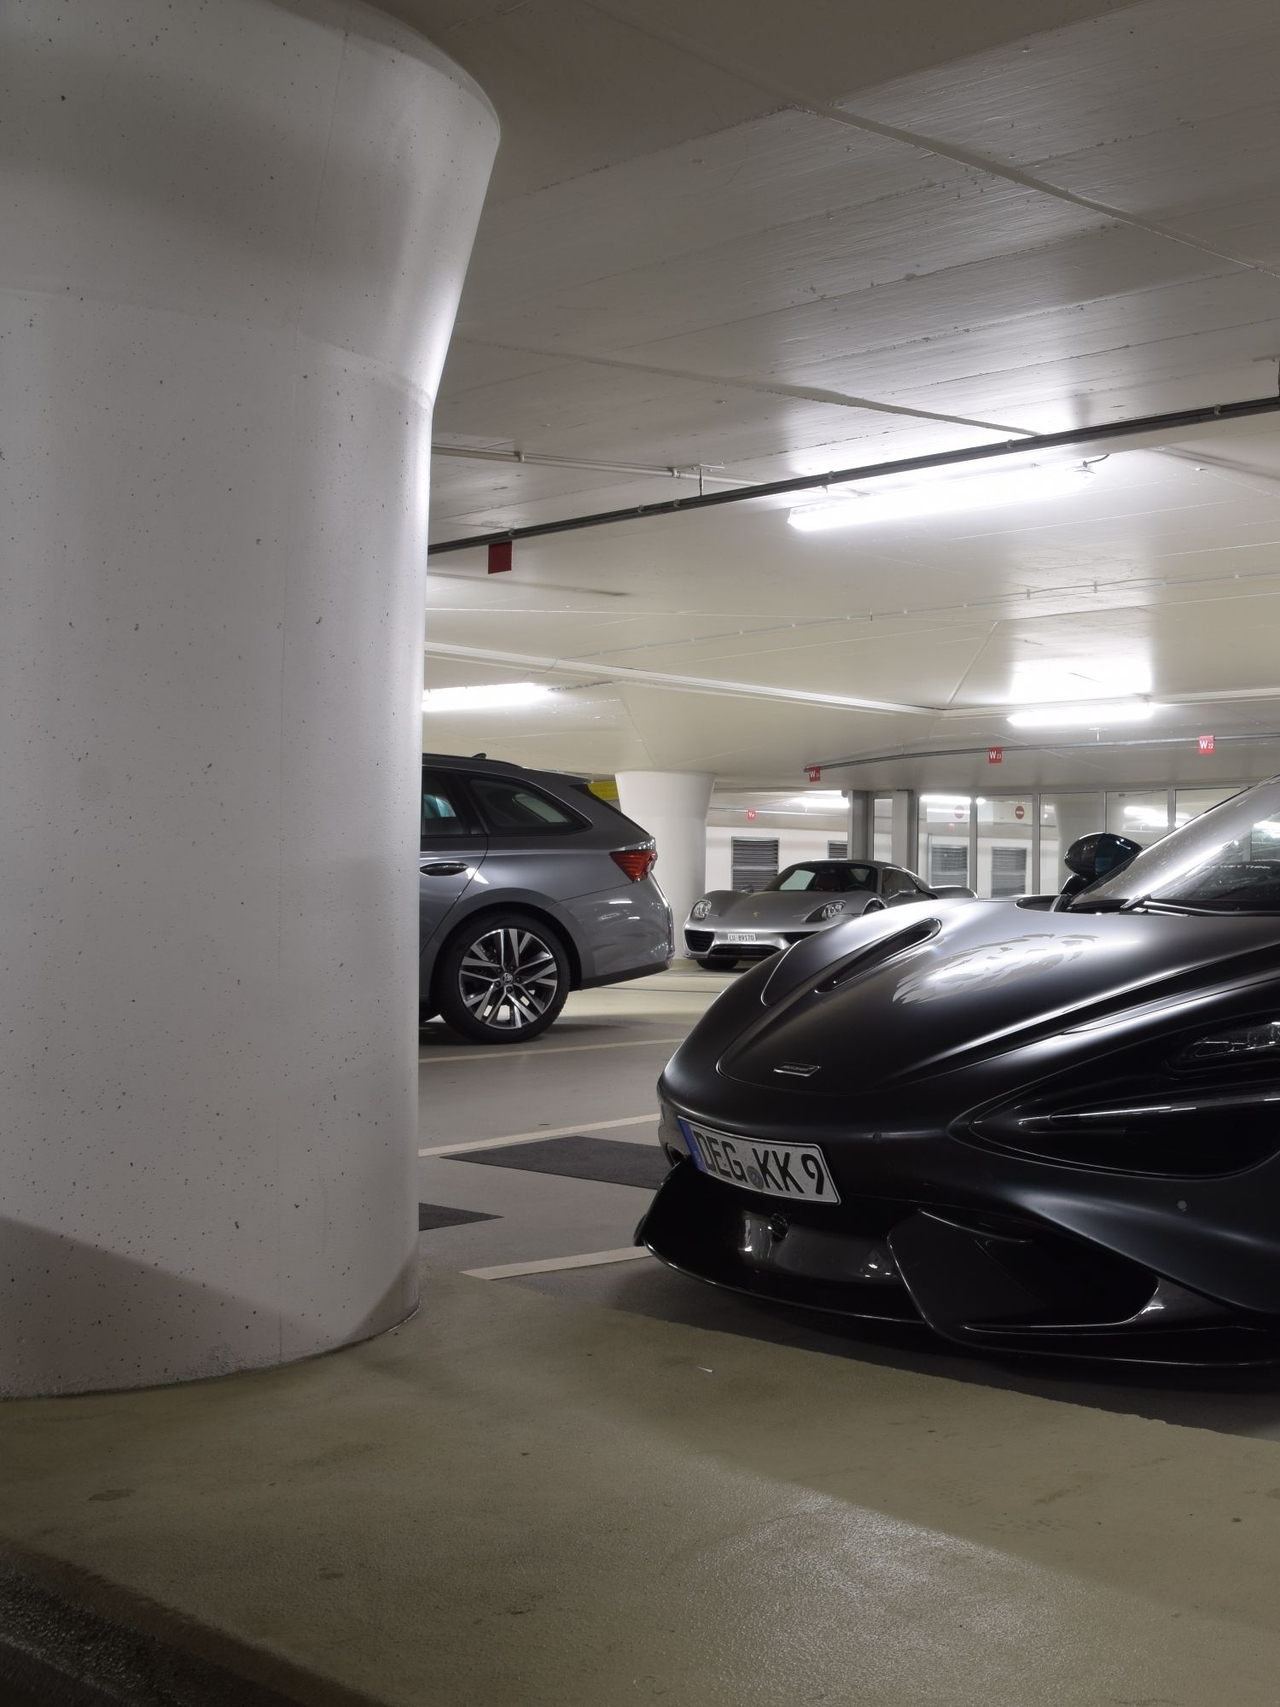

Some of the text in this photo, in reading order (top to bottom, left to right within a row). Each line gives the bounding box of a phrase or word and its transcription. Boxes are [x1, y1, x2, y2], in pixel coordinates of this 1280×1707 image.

[1199, 740, 1208, 749] W
[990, 750, 997, 759] W
[692, 1131, 825, 1196] DEG KK 9
